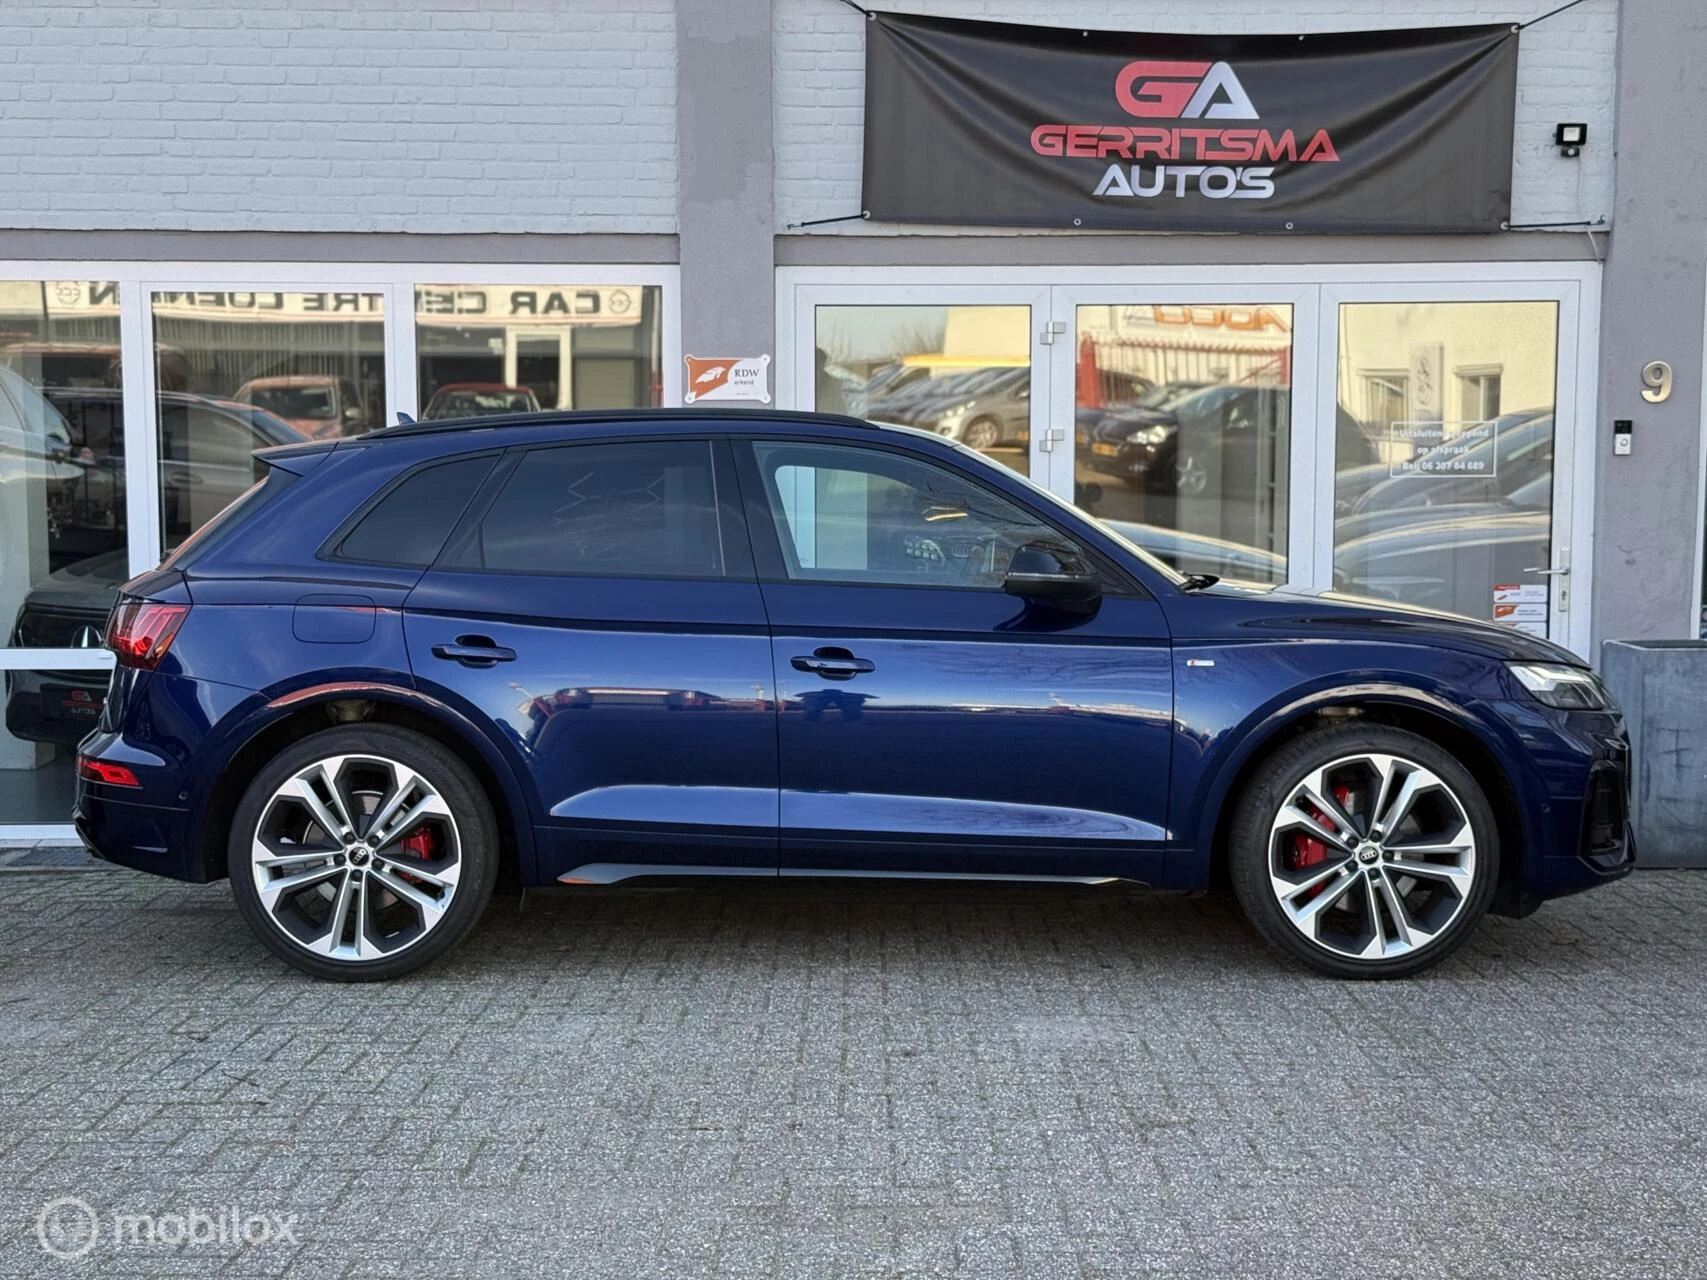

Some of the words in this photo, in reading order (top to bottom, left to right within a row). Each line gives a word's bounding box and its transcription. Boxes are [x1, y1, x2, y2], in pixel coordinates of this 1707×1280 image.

[1115, 60, 1260, 119] GA
[1030, 124, 1341, 162] GERRITSMA
[1093, 163, 1275, 199] AUTO'S
[734, 369, 759, 377] RDW
[1641, 360, 1673, 404] 9
[1421, 461, 1433, 470] 06
